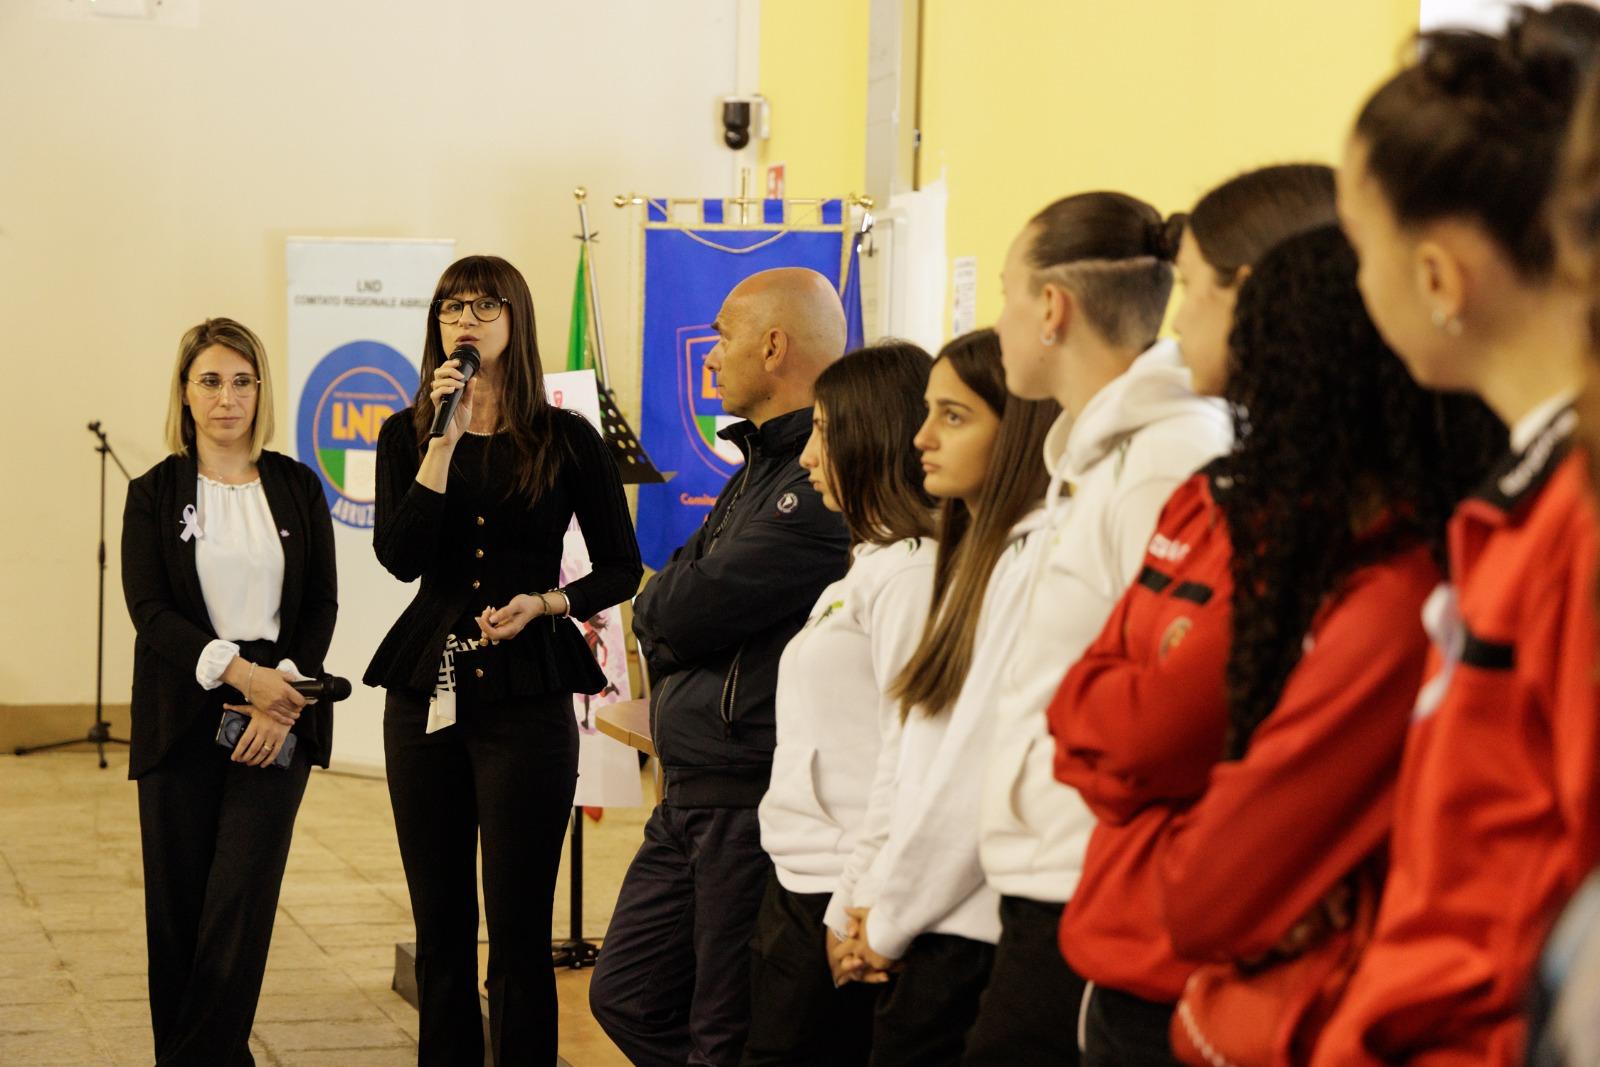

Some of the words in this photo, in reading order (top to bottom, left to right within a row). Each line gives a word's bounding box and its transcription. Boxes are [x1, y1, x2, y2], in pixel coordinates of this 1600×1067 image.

[356, 279, 383, 293] LND
[294, 295, 341, 307] COMITATO
[343, 296, 396, 308] REGIONALE
